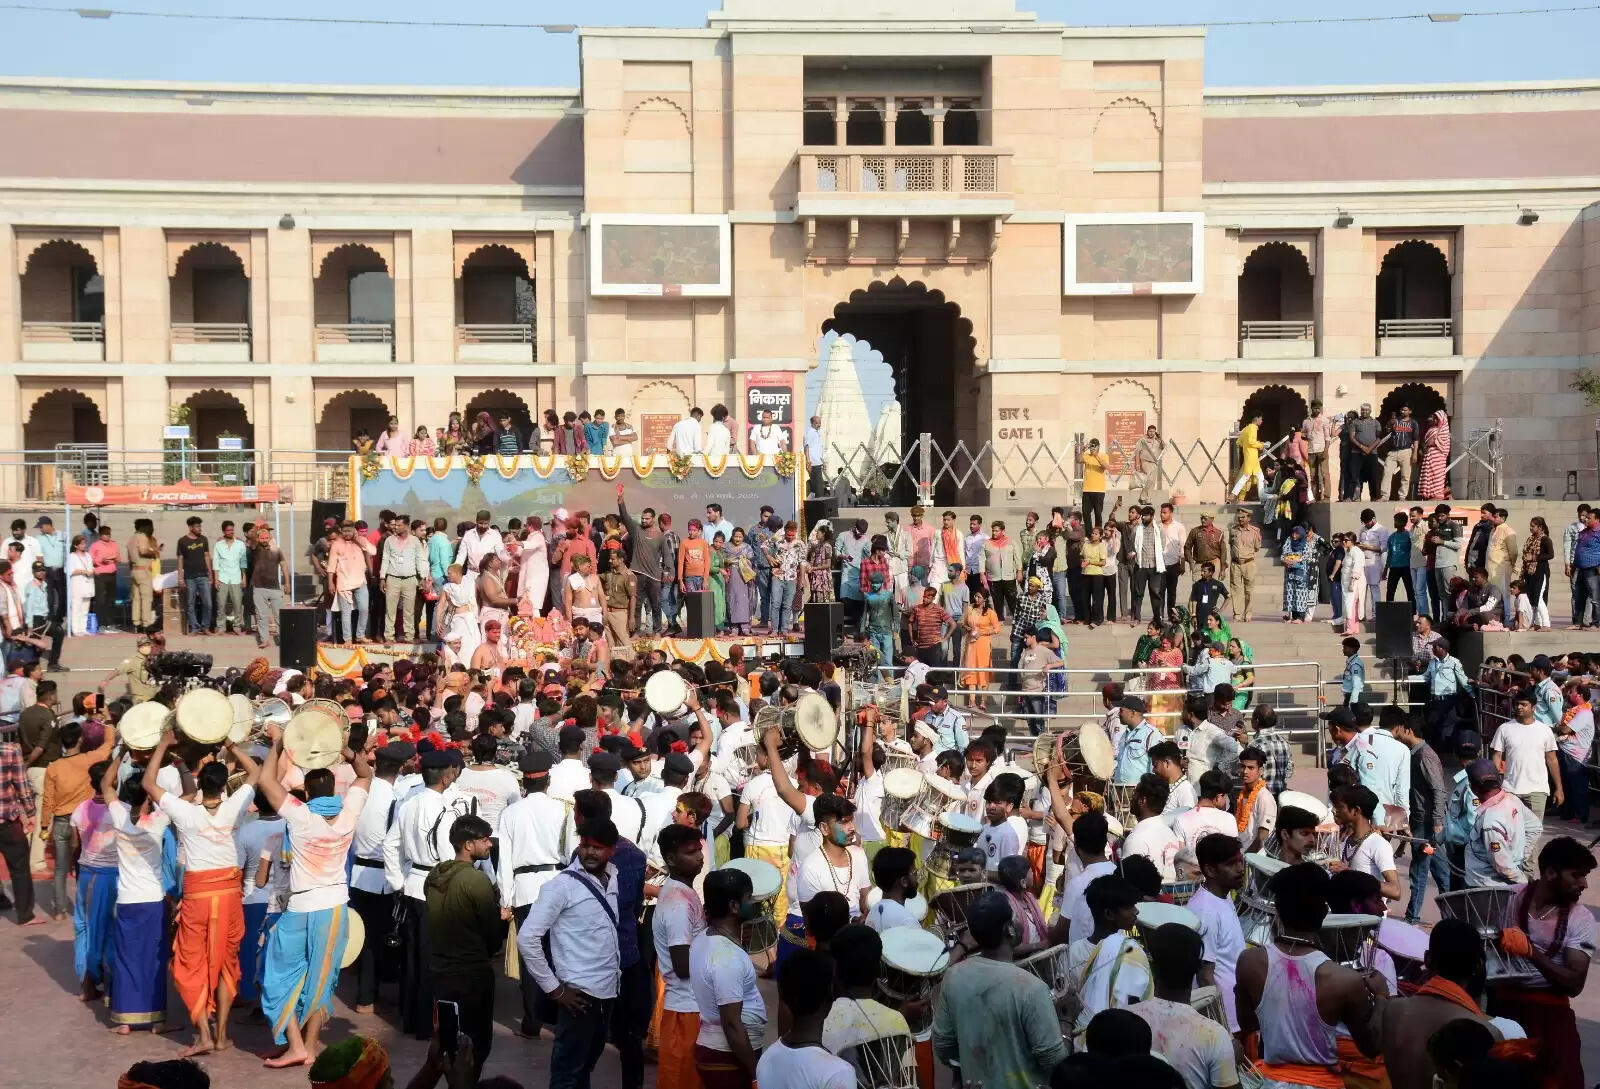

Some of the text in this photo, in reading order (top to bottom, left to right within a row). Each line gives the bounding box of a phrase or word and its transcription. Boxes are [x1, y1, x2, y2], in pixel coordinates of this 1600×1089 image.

[749, 389, 791, 405] निकास
[756, 406, 783, 421] मर्ग
[998, 408, 1020, 420] द्वार
[998, 427, 1044, 439] GATE 1
[180, 492, 208, 500] Bank
